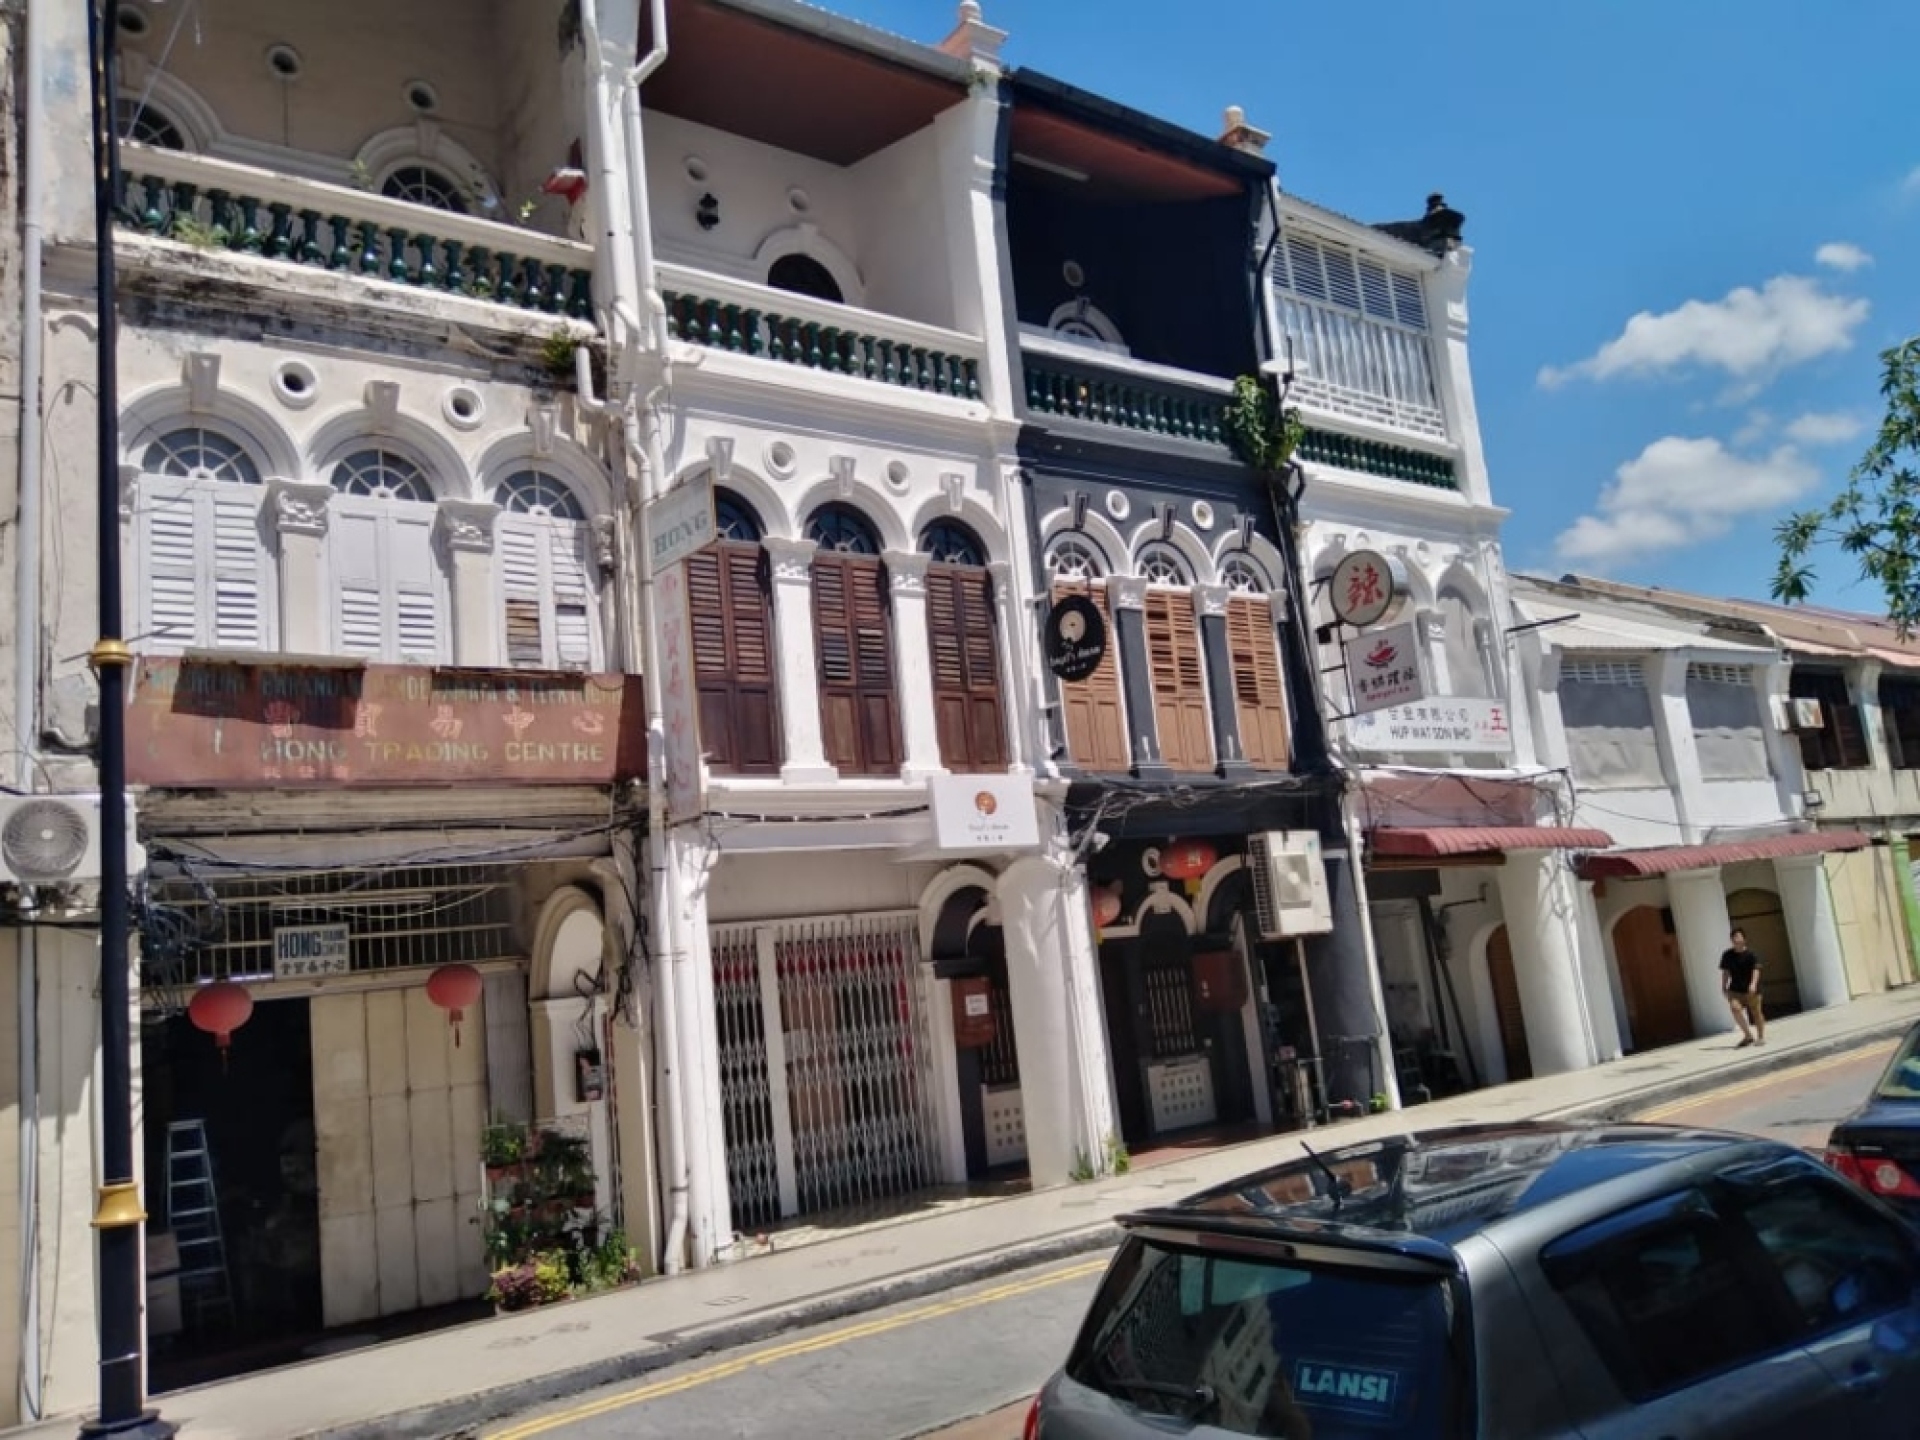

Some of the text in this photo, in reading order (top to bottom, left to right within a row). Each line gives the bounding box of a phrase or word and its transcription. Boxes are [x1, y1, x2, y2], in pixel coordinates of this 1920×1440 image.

[652, 509, 708, 556] HONG
[261, 738, 605, 764] HONG TRADING CENTRE
[277, 930, 321, 960] HONG
[1299, 1366, 1389, 1403] LANSI
